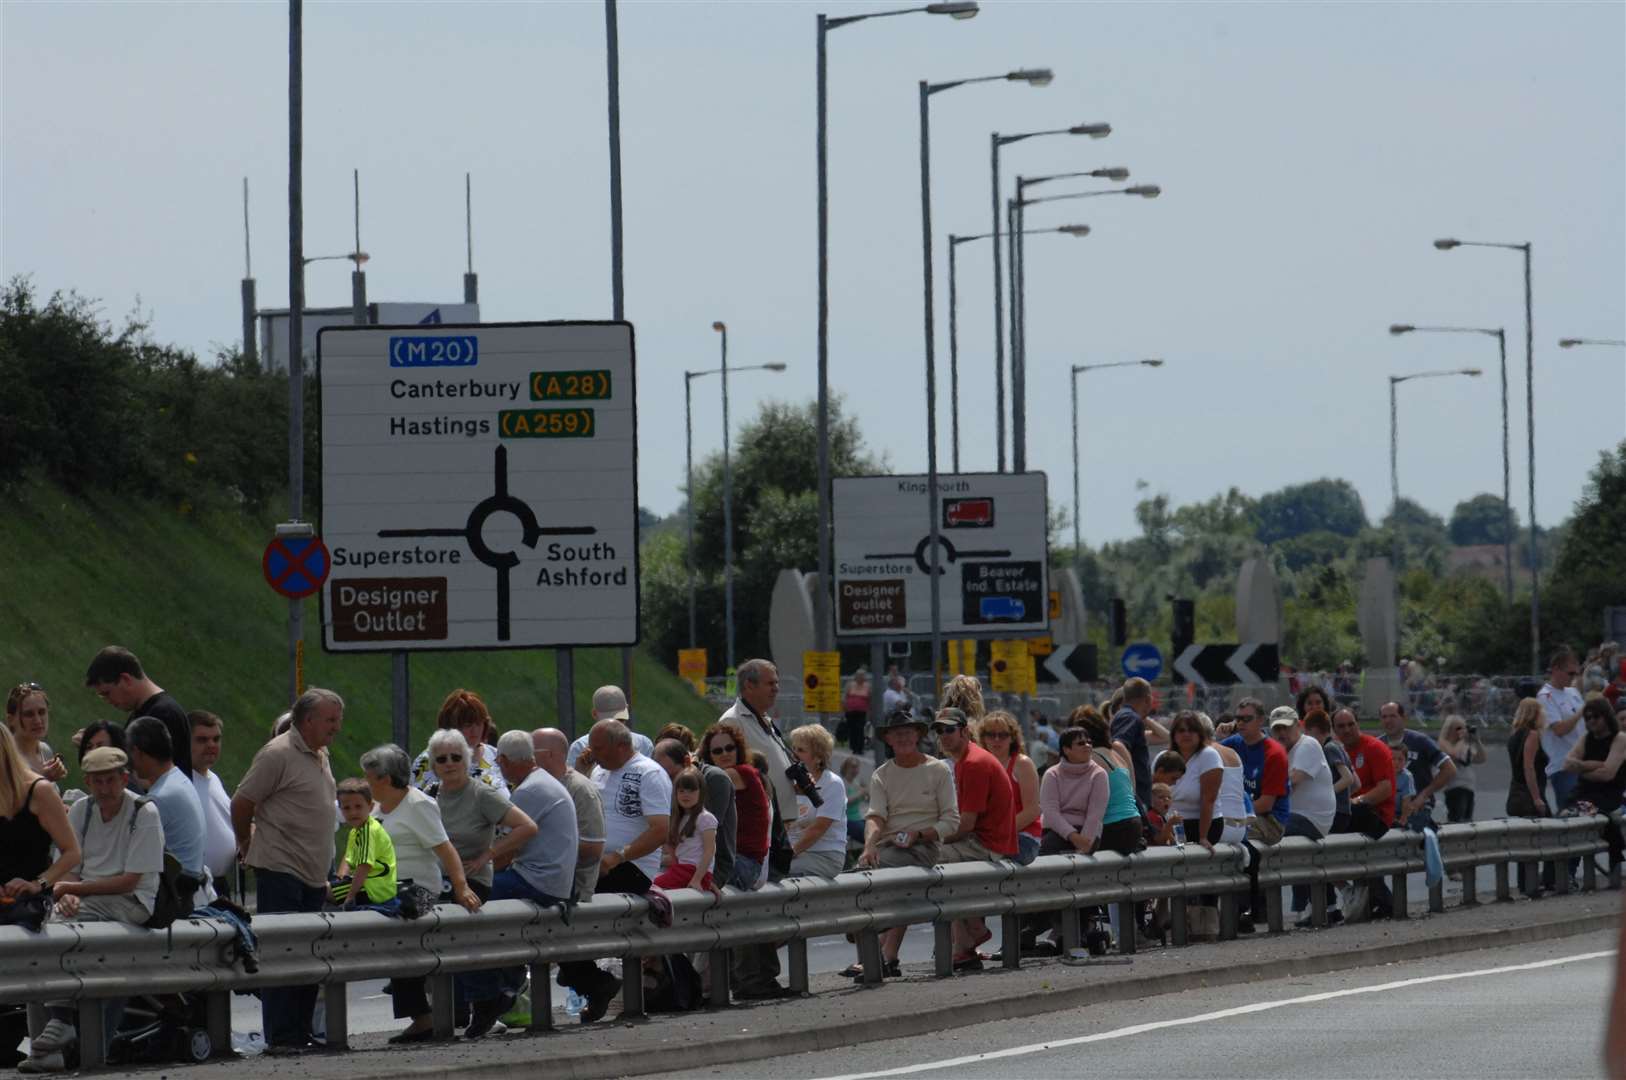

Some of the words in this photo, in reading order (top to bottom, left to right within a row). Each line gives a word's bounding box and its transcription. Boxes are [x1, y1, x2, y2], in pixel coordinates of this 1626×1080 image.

[393, 340, 474, 363] (M20)
[390, 379, 520, 400] Canterbury
[533, 373, 608, 398] (A28)
[390, 416, 490, 437] Hastings
[502, 410, 592, 435] (A259)
[332, 546, 462, 568] Superstore
[547, 542, 616, 561] South
[536, 567, 627, 587] Ashford
[839, 563, 913, 576] Superstore
[979, 565, 1025, 577] Beaver
[843, 584, 901, 598] Designer
[995, 579, 1039, 592] Estate
[340, 586, 438, 609] Designer
[852, 598, 893, 610] outlet
[353, 610, 426, 632] Outlet
[852, 612, 894, 625] centre
